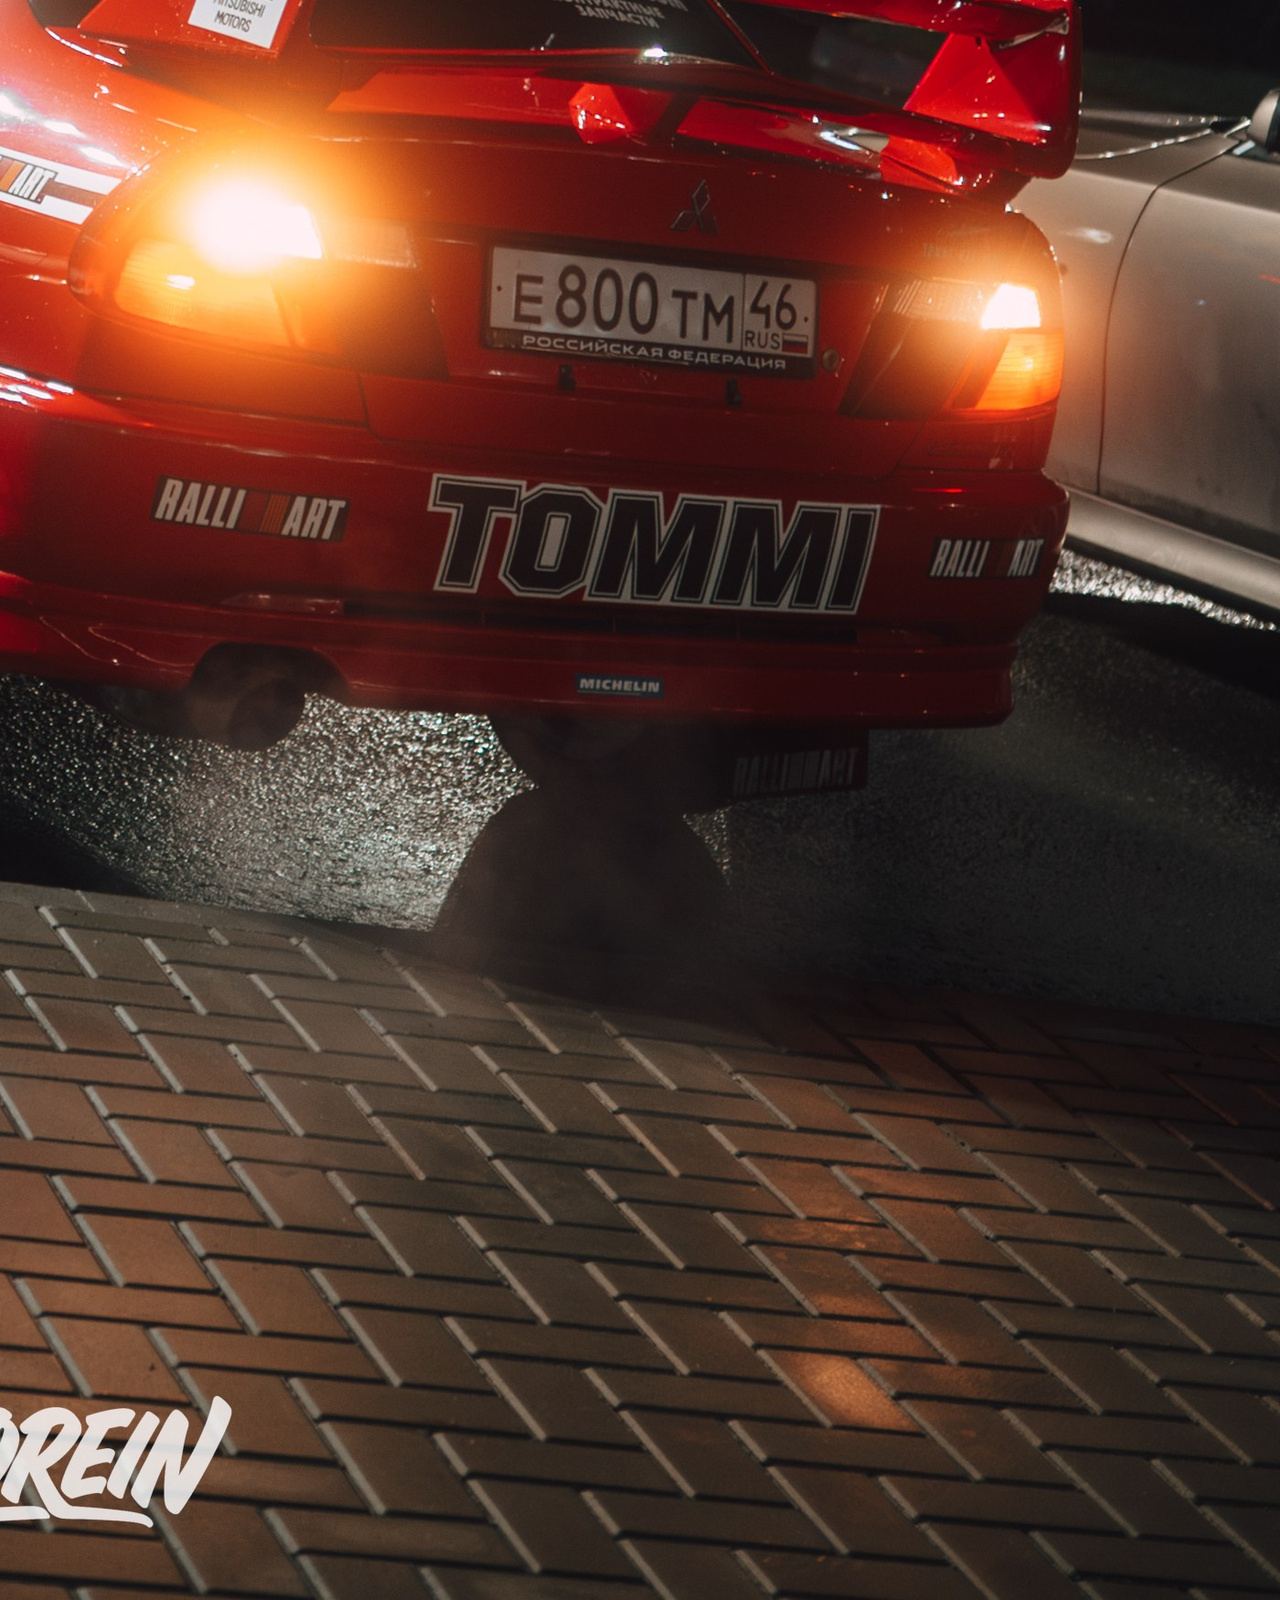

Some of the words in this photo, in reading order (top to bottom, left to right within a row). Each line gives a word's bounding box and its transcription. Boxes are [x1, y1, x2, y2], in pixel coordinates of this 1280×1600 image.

[214, 10, 252, 33] MOTORS
[574, 4, 660, 29] ЗАПЧАСТИ
[7, 163, 58, 201] ART
[750, 281, 797, 331] 46
[522, 334, 664, 359] РОССИЙСКАЯ
[667, 348, 787, 370] ФЕДЕРАЦИЯ
[745, 330, 781, 350] RUS
[154, 477, 247, 529] RALLI
[280, 495, 347, 541] ART
[429, 472, 882, 616] TOMMI
[929, 539, 991, 577] RALLI
[1006, 539, 1045, 577] ART
[579, 678, 660, 693] MICHELIN
